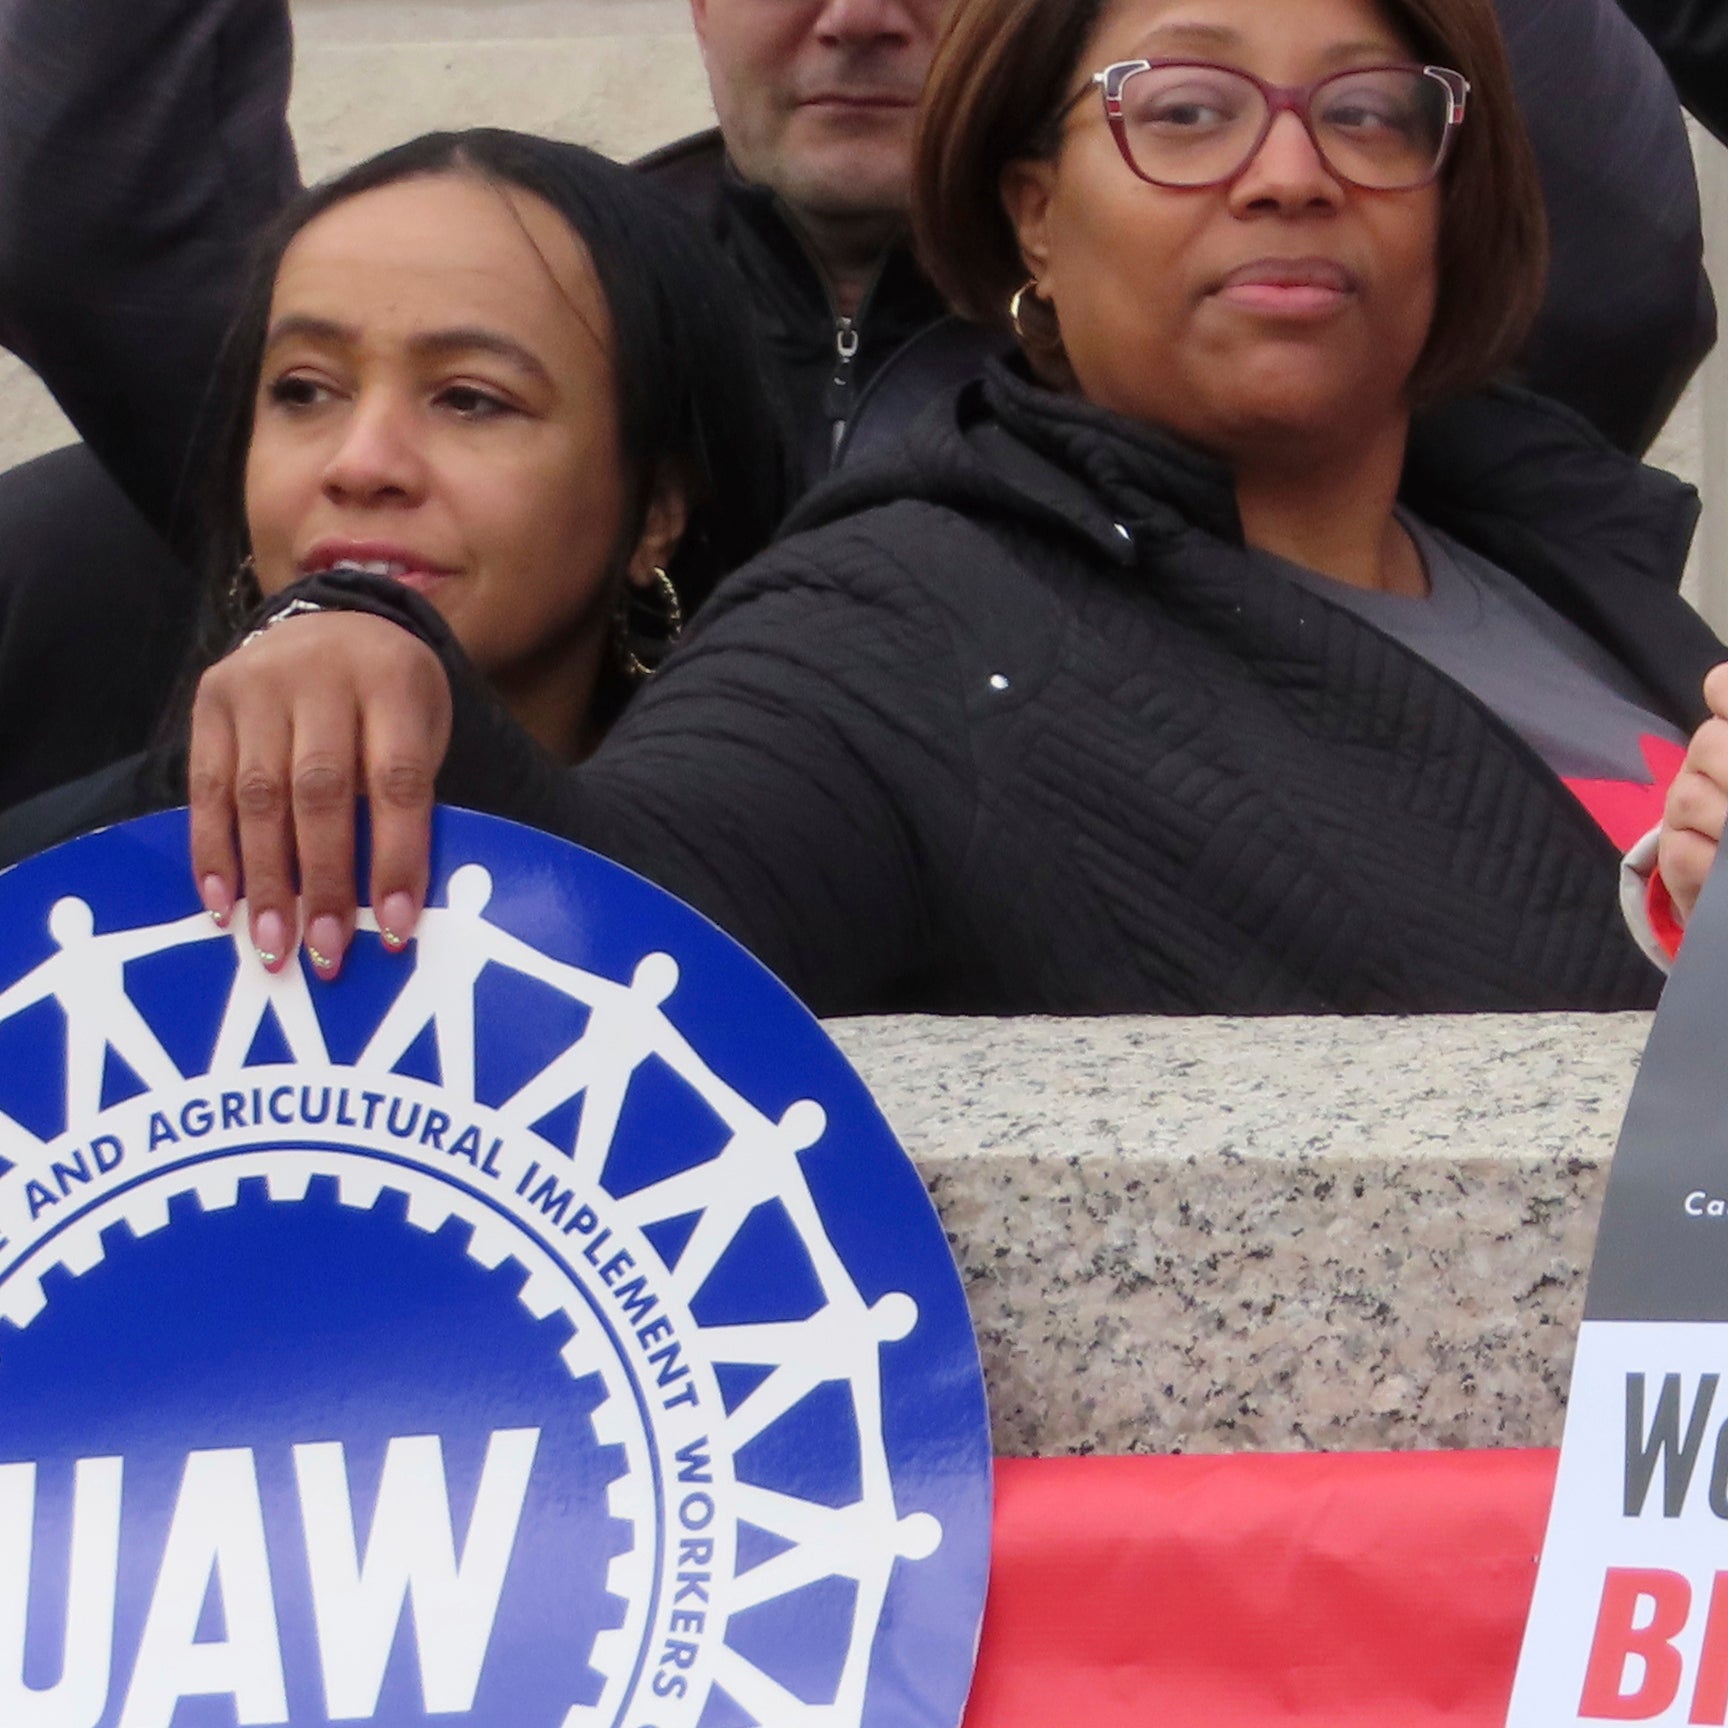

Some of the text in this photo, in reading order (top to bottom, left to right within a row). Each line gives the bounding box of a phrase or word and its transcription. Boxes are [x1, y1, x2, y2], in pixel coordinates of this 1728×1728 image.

[0, 1426, 541, 1728] UAW
[24, 1085, 717, 1700] AND AGRICULTURAL IMPLEMENT WORKERS
